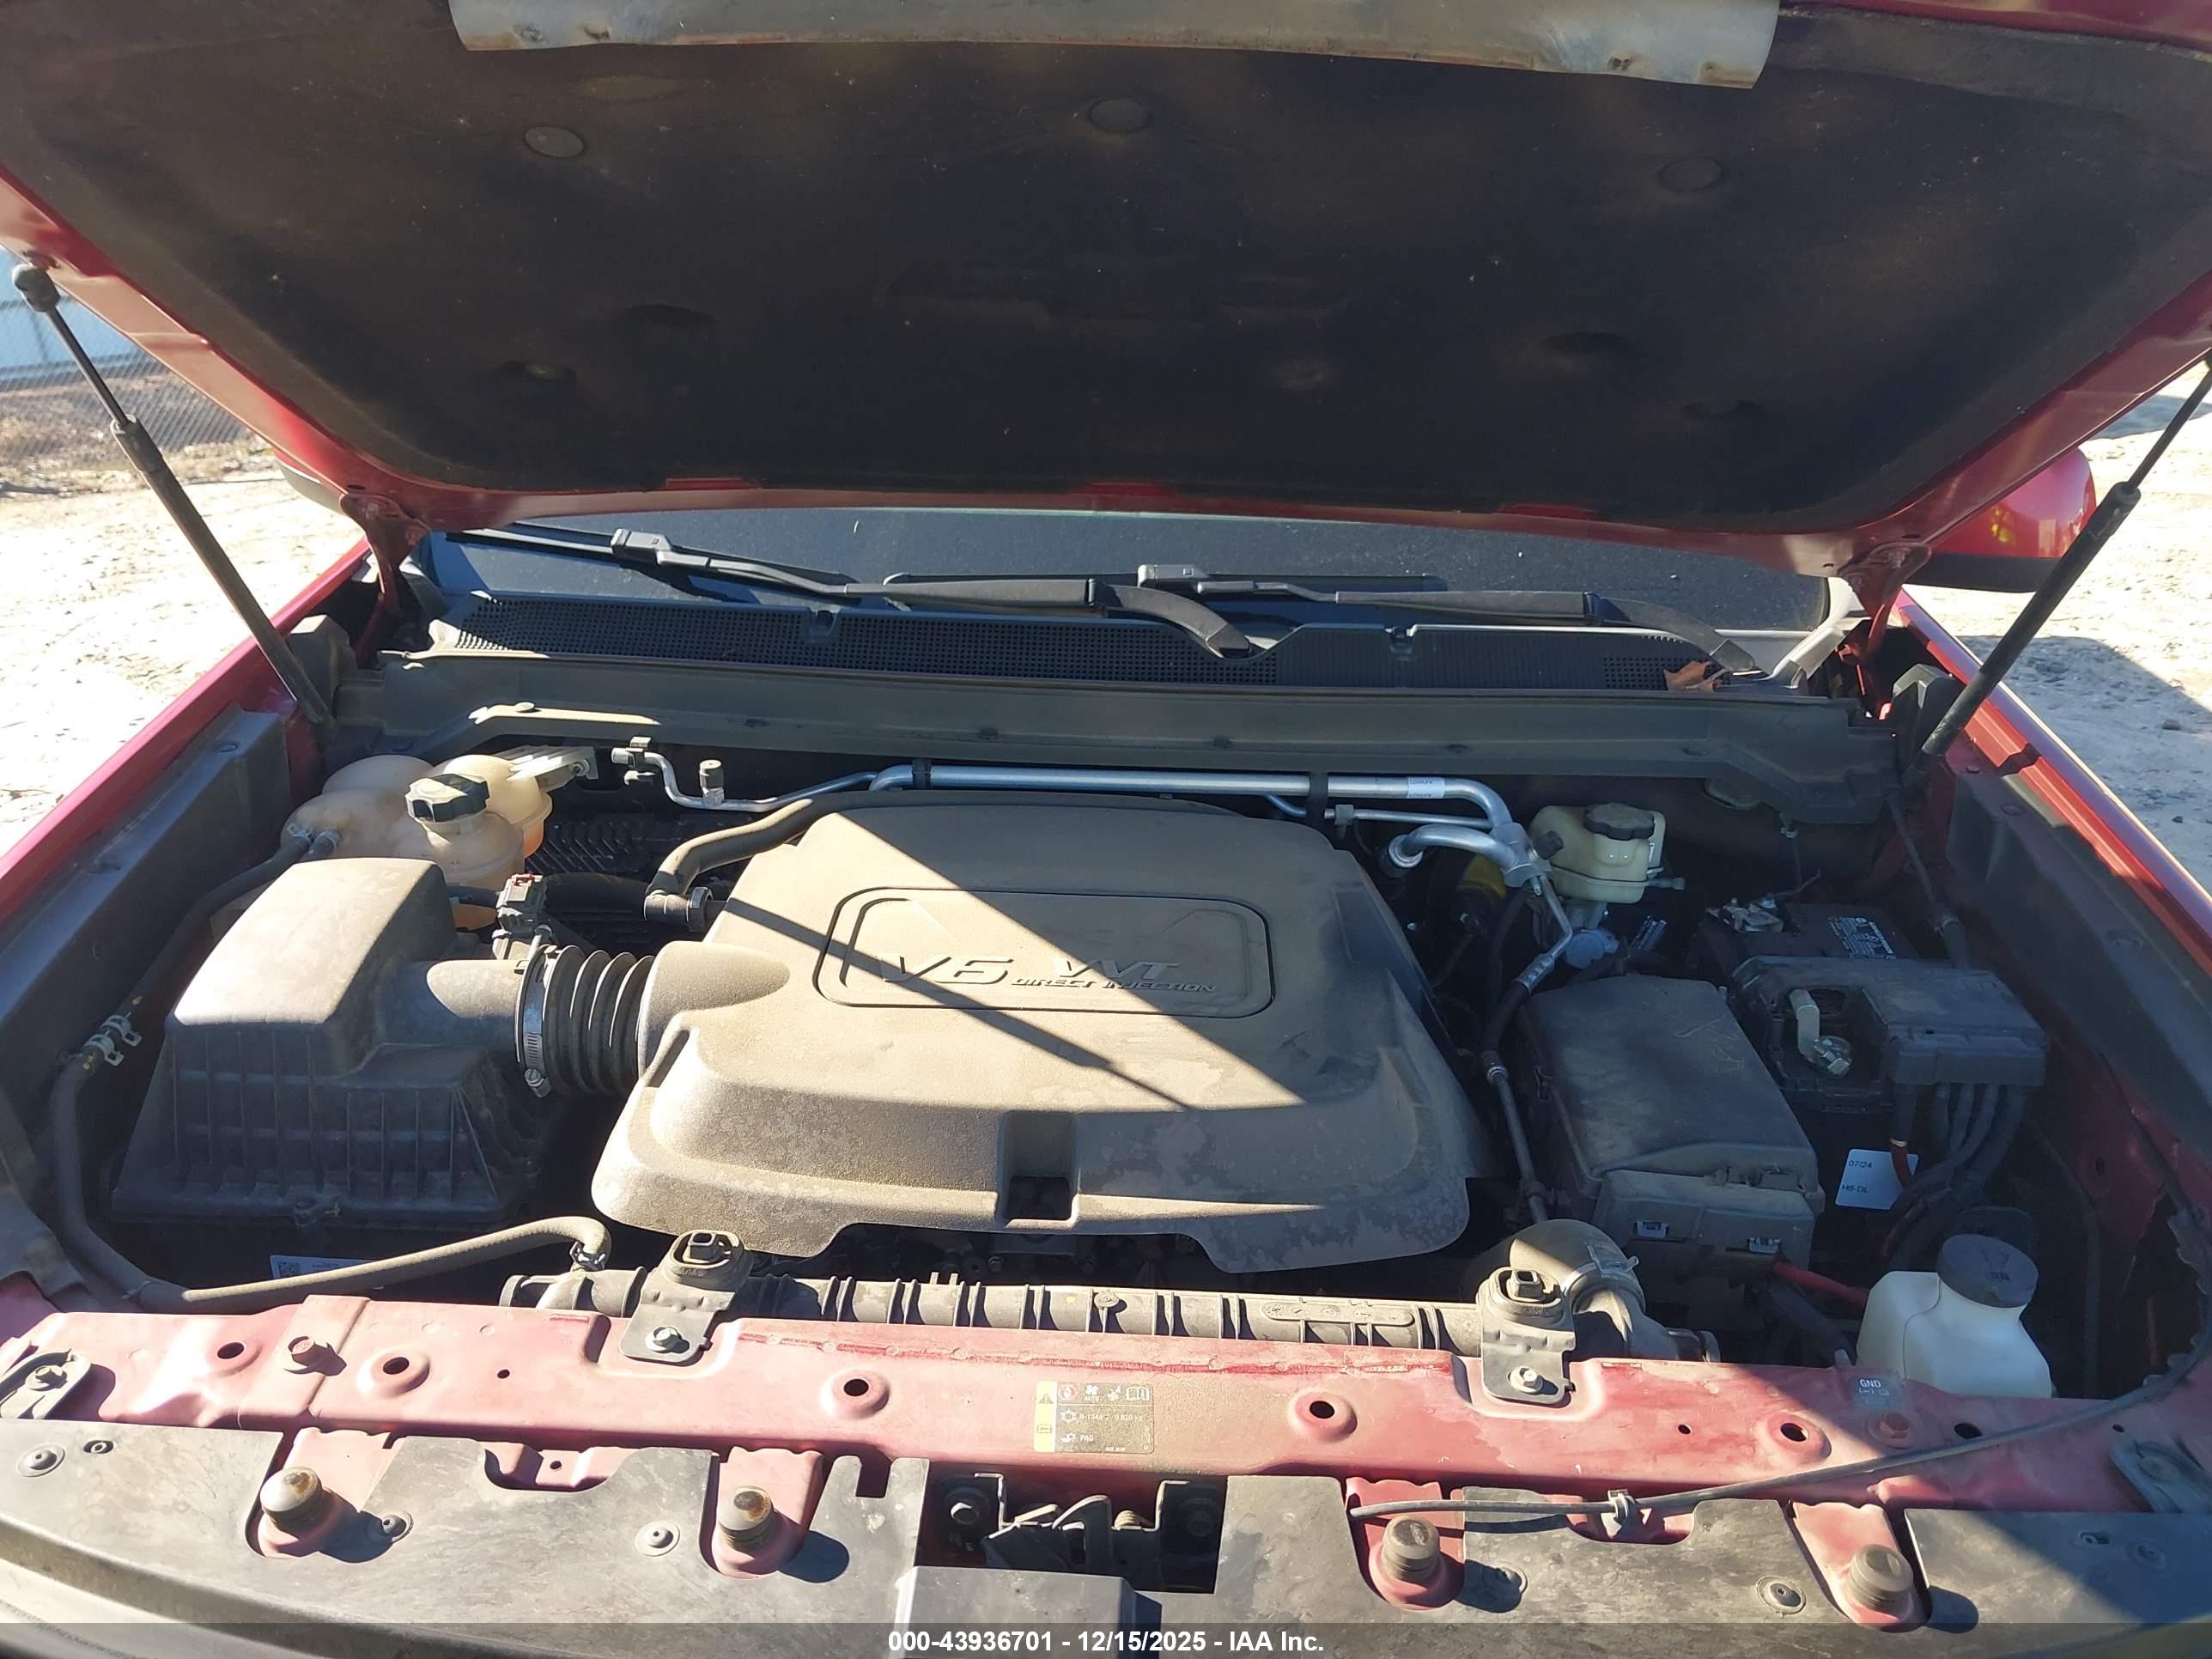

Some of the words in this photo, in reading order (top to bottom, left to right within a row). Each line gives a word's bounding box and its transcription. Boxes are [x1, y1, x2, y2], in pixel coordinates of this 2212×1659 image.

[879, 953, 1014, 985] V6
[1053, 957, 1179, 980] VVT
[1012, 978, 1097, 988] DIRECT
[1103, 981, 1216, 993] INJECTION
[1859, 1379, 1881, 1388] GND
